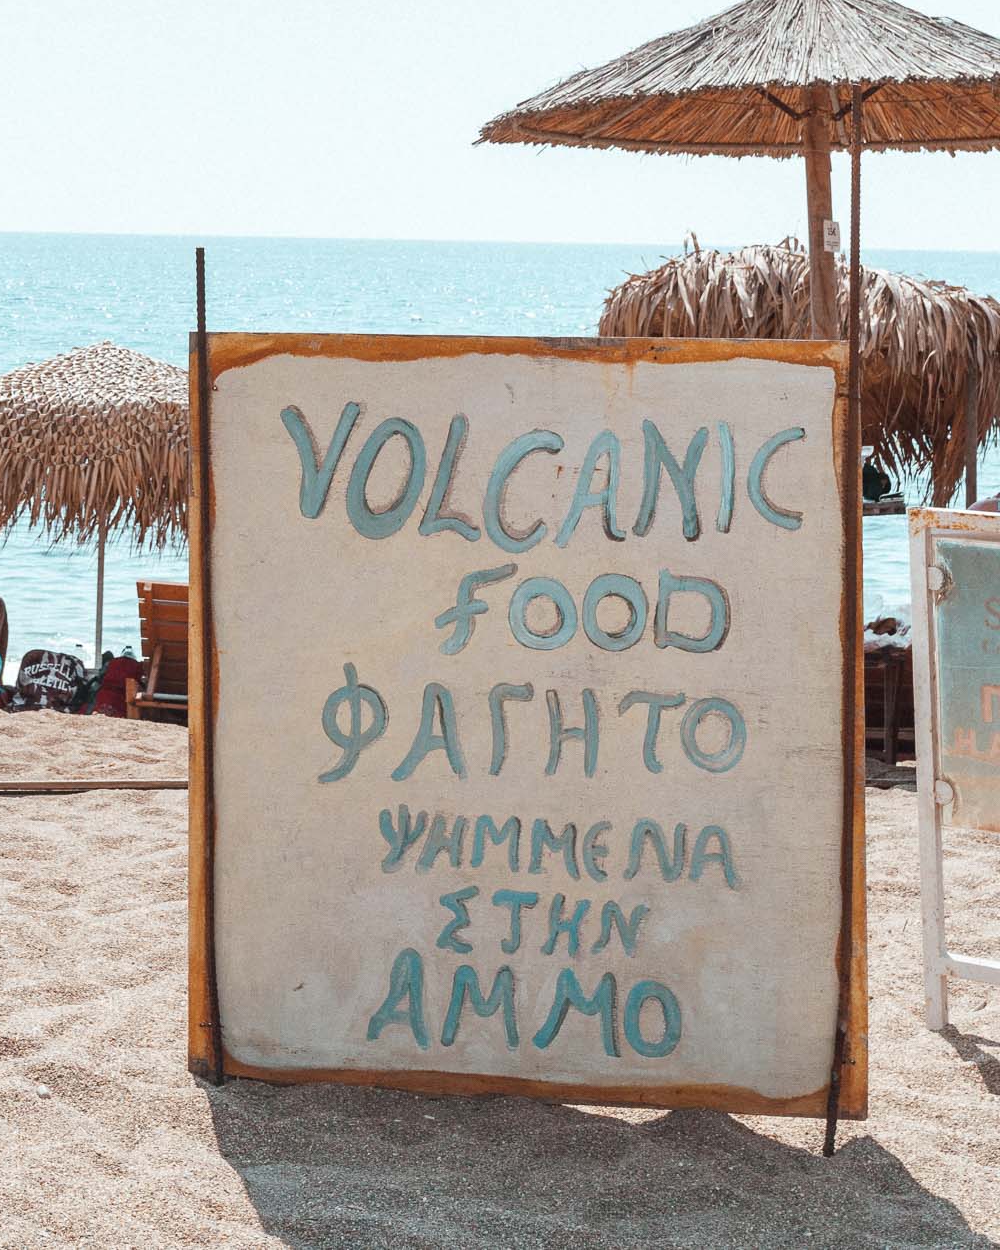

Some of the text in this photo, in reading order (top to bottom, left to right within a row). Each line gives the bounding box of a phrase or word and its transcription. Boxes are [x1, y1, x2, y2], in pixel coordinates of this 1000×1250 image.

[281, 402, 805, 552] VOLCANIC
[435, 563, 730, 654] FOOD
[24, 662, 72, 681] RUSSELL
[317, 662, 747, 783] ΦΑΓΗΤΟ
[379, 803, 742, 889] ΨΗΜΜΕΝΑ
[436, 885, 650, 957] ΣΤΗΝ
[366, 948, 683, 1058] ΑΜΜΟ
